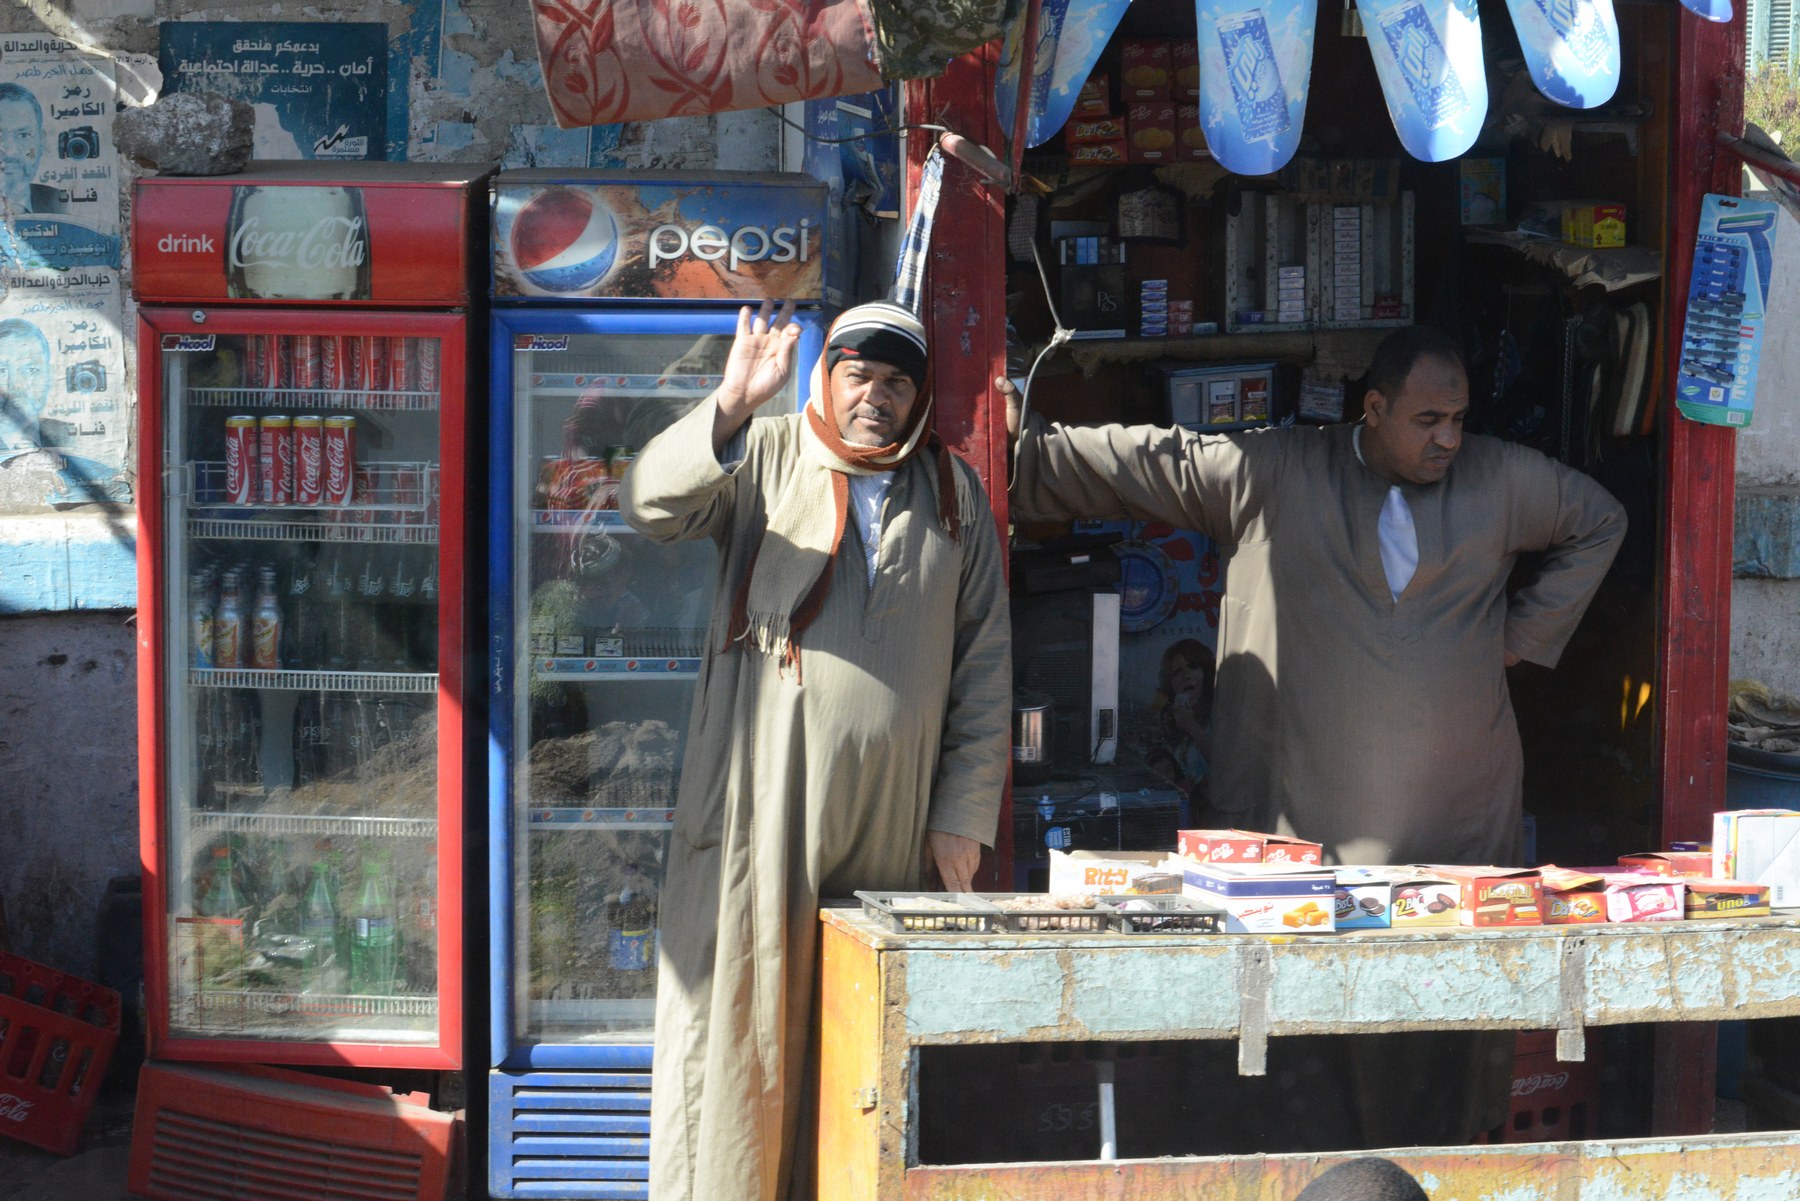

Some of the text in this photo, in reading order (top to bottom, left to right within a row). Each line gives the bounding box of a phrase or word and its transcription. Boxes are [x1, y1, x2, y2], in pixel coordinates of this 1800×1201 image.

[232, 39, 320, 56] بدعمكم هنحقق
[240, 59, 279, 74] عدالة
[292, 61, 325, 77] حرية
[339, 56, 374, 76] أمان
[271, 85, 312, 95] انتخابات
[51, 102, 105, 120] الكاميرا
[157, 234, 215, 253] drink
[231, 216, 366, 269] Coca-Cola
[649, 218, 809, 271] pepsi
[301, 432, 321, 495] Coca-Cola
[326, 433, 345, 495] Coca-Cola
[1063, 827, 1072, 847] EXTRA
